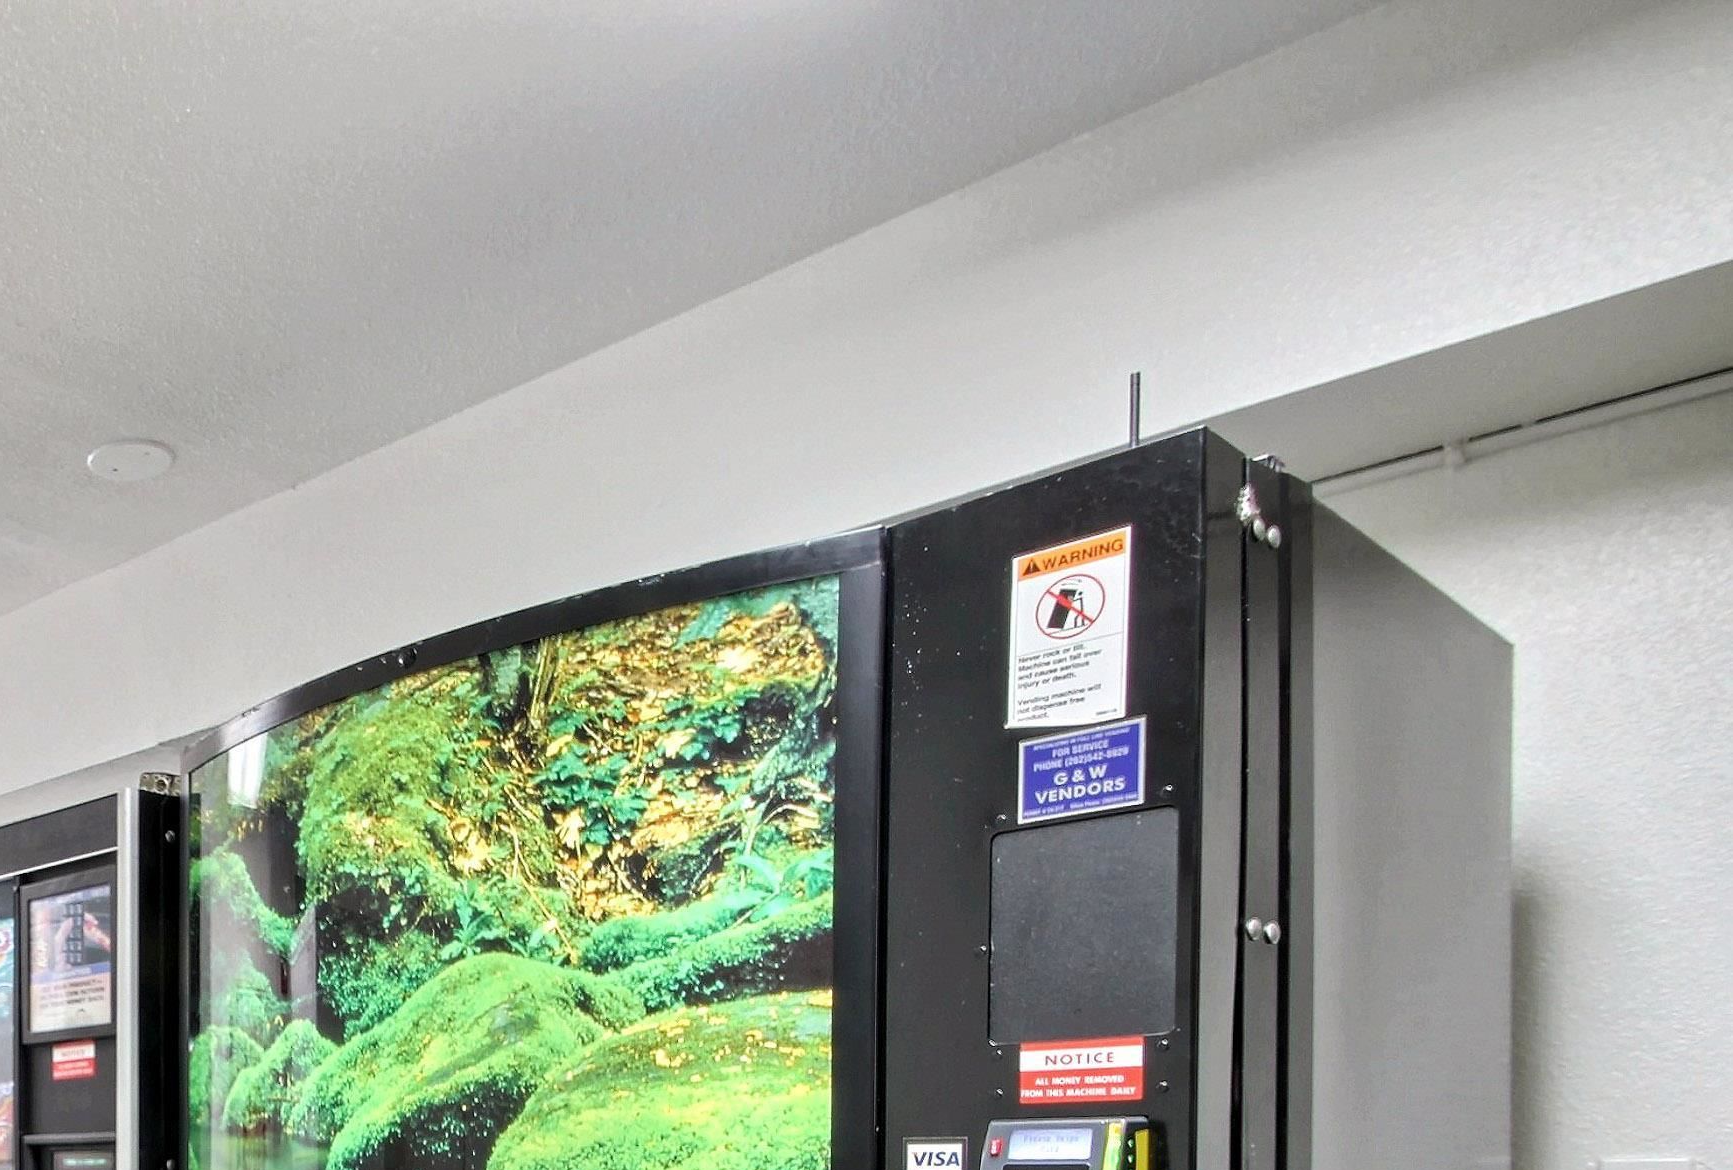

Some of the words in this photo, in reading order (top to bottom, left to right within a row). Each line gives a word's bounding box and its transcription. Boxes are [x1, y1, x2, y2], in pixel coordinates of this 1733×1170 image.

[1042, 539, 1124, 570] WARNING
[1018, 654, 1041, 664] Never
[1043, 650, 1060, 659] rock
[1018, 661, 1051, 672] Machine
[1053, 657, 1067, 665] can
[1069, 652, 1082, 661] fall
[1084, 649, 1102, 658] over
[1018, 672, 1033, 681] and
[1034, 667, 1058, 678] cause
[1060, 661, 1090, 672] serious
[1018, 680, 1040, 690] injury
[1018, 696, 1049, 706] Vending
[1051, 688, 1085, 699] machine
[1087, 683, 1102, 692] will
[1031, 700, 1068, 712] dispense
[1052, 747, 1070, 758] FOR
[1072, 739, 1109, 754] SERVICE
[1034, 758, 1063, 772] PHONE
[1053, 771, 1069, 786] G
[1072, 769, 1086, 783] &
[1088, 764, 1108, 779] W
[1035, 777, 1126, 804] VENDORS
[1045, 1052, 1114, 1066] NOTICE
[1035, 1077, 1049, 1086] ALL
[1051, 1076, 1082, 1085] MONEY
[1084, 1075, 1125, 1085] REMOVED
[1020, 1089, 1044, 1098] FROM
[1045, 1089, 1065, 1097] THIS
[1066, 1088, 1107, 1097] MACHINE
[1110, 1087, 1136, 1096] DAILY
[912, 1151, 960, 1166] VISA
